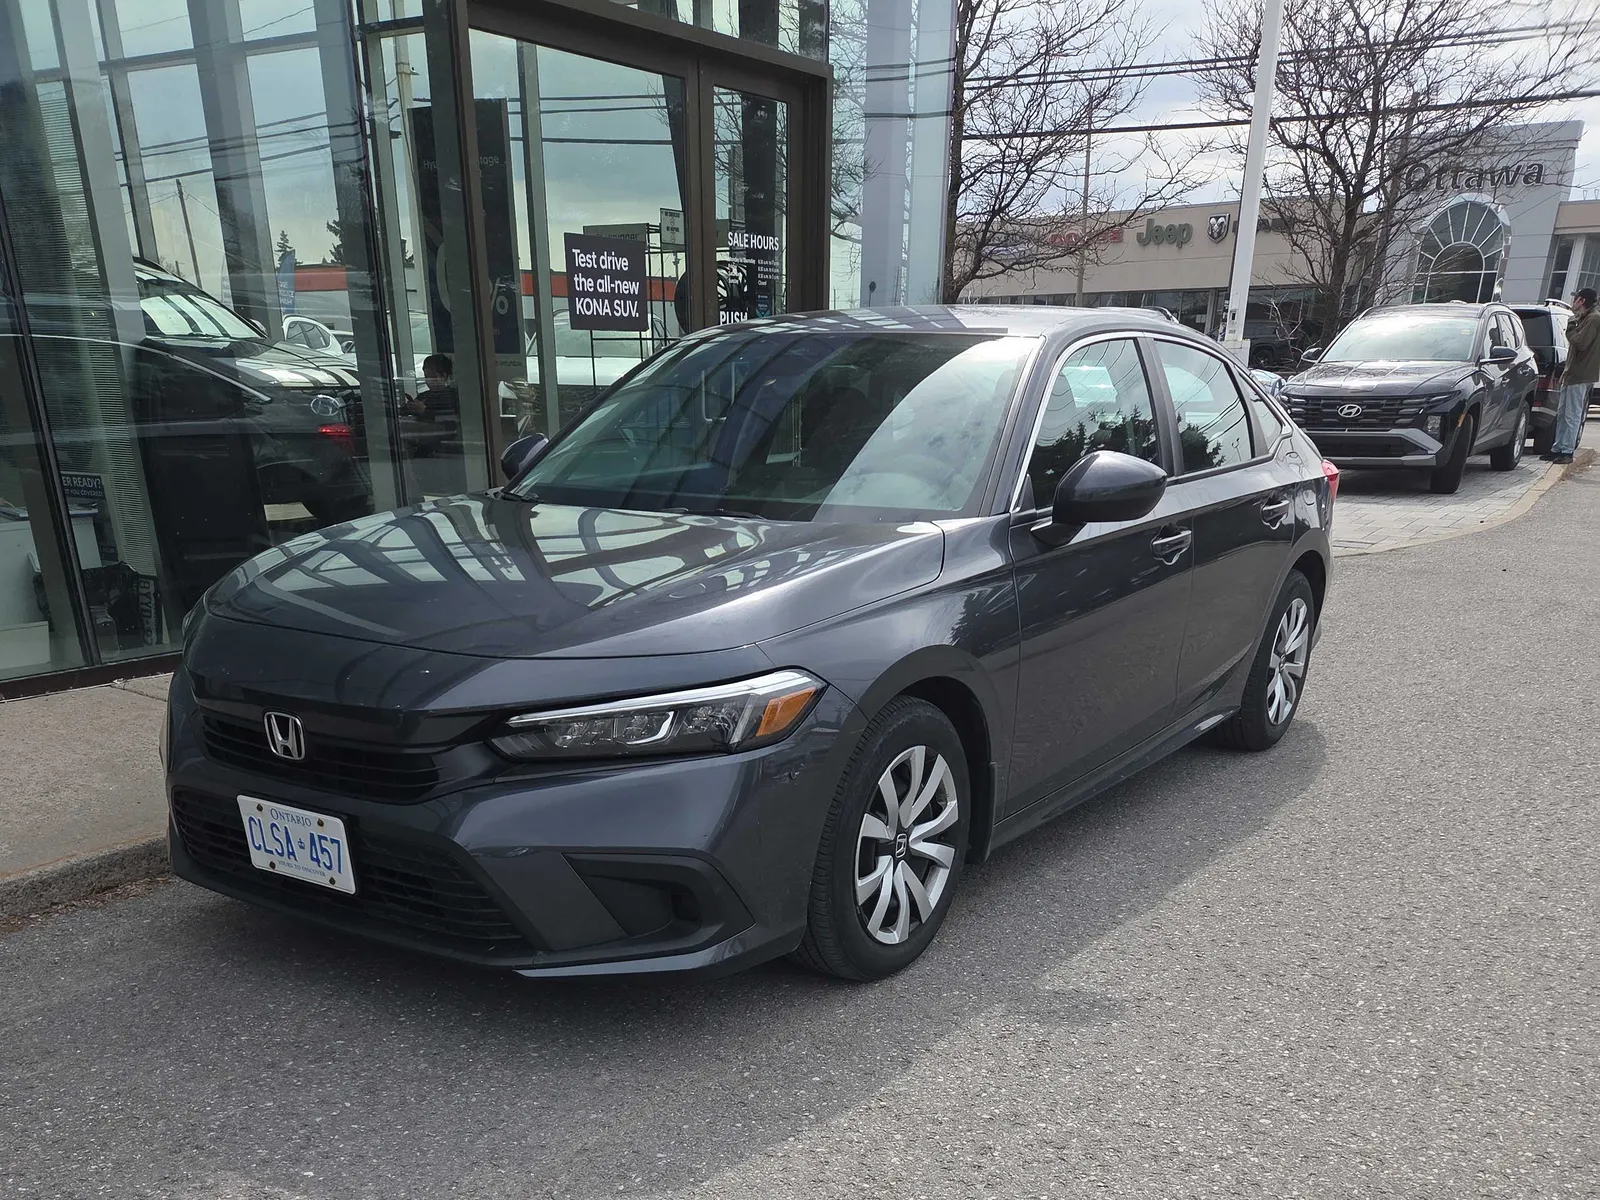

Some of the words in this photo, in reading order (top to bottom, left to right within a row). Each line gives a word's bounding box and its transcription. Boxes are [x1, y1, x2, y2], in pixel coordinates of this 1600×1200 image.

[1405, 162, 1546, 192] Ottawa
[728, 231, 749, 248] SALE
[750, 234, 780, 251] HOURS
[1136, 218, 1193, 248] Jeep
[572, 248, 598, 269] Test
[599, 250, 629, 272] drive
[574, 272, 594, 292] the
[596, 274, 640, 295] all-new
[575, 297, 612, 317] KONA
[613, 299, 640, 318] SUV.
[73, 477, 101, 489] READY?
[247, 816, 298, 862] CLSA
[309, 831, 343, 875] 457
